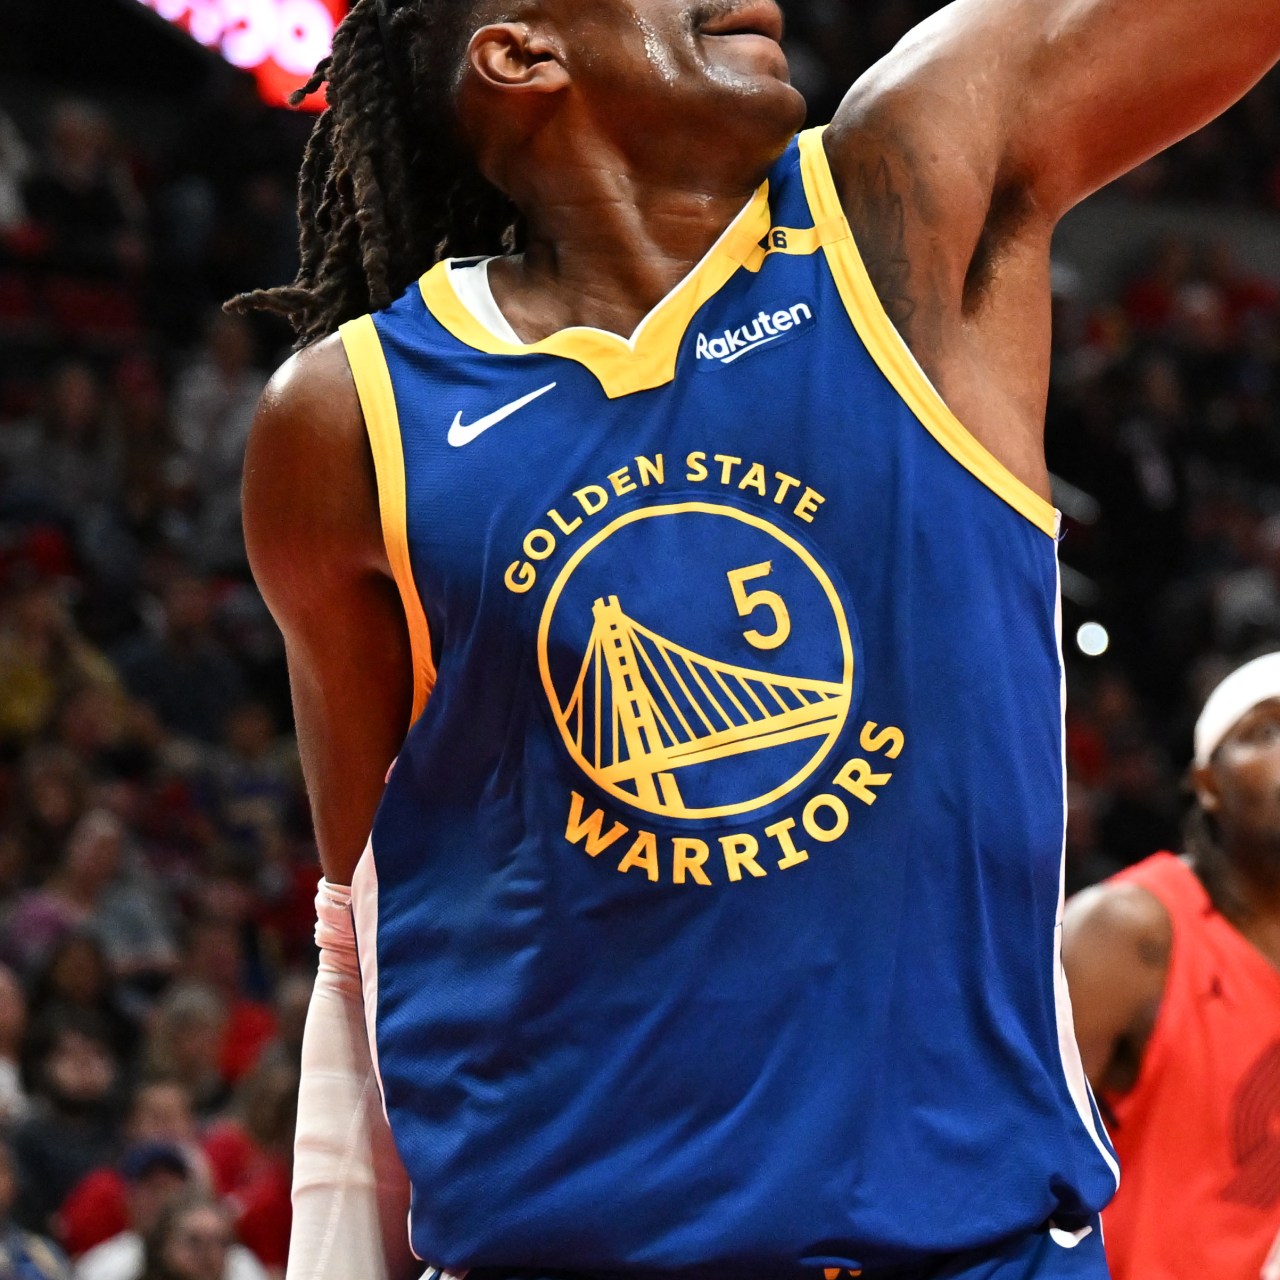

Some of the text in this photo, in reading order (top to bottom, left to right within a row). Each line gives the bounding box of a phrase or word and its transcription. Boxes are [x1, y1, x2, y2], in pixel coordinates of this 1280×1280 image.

[695, 302, 812, 362] Rakuten
[504, 450, 827, 594] GOLDEN STATE
[726, 559, 792, 651] 5
[564, 719, 905, 887] WARRIORS
